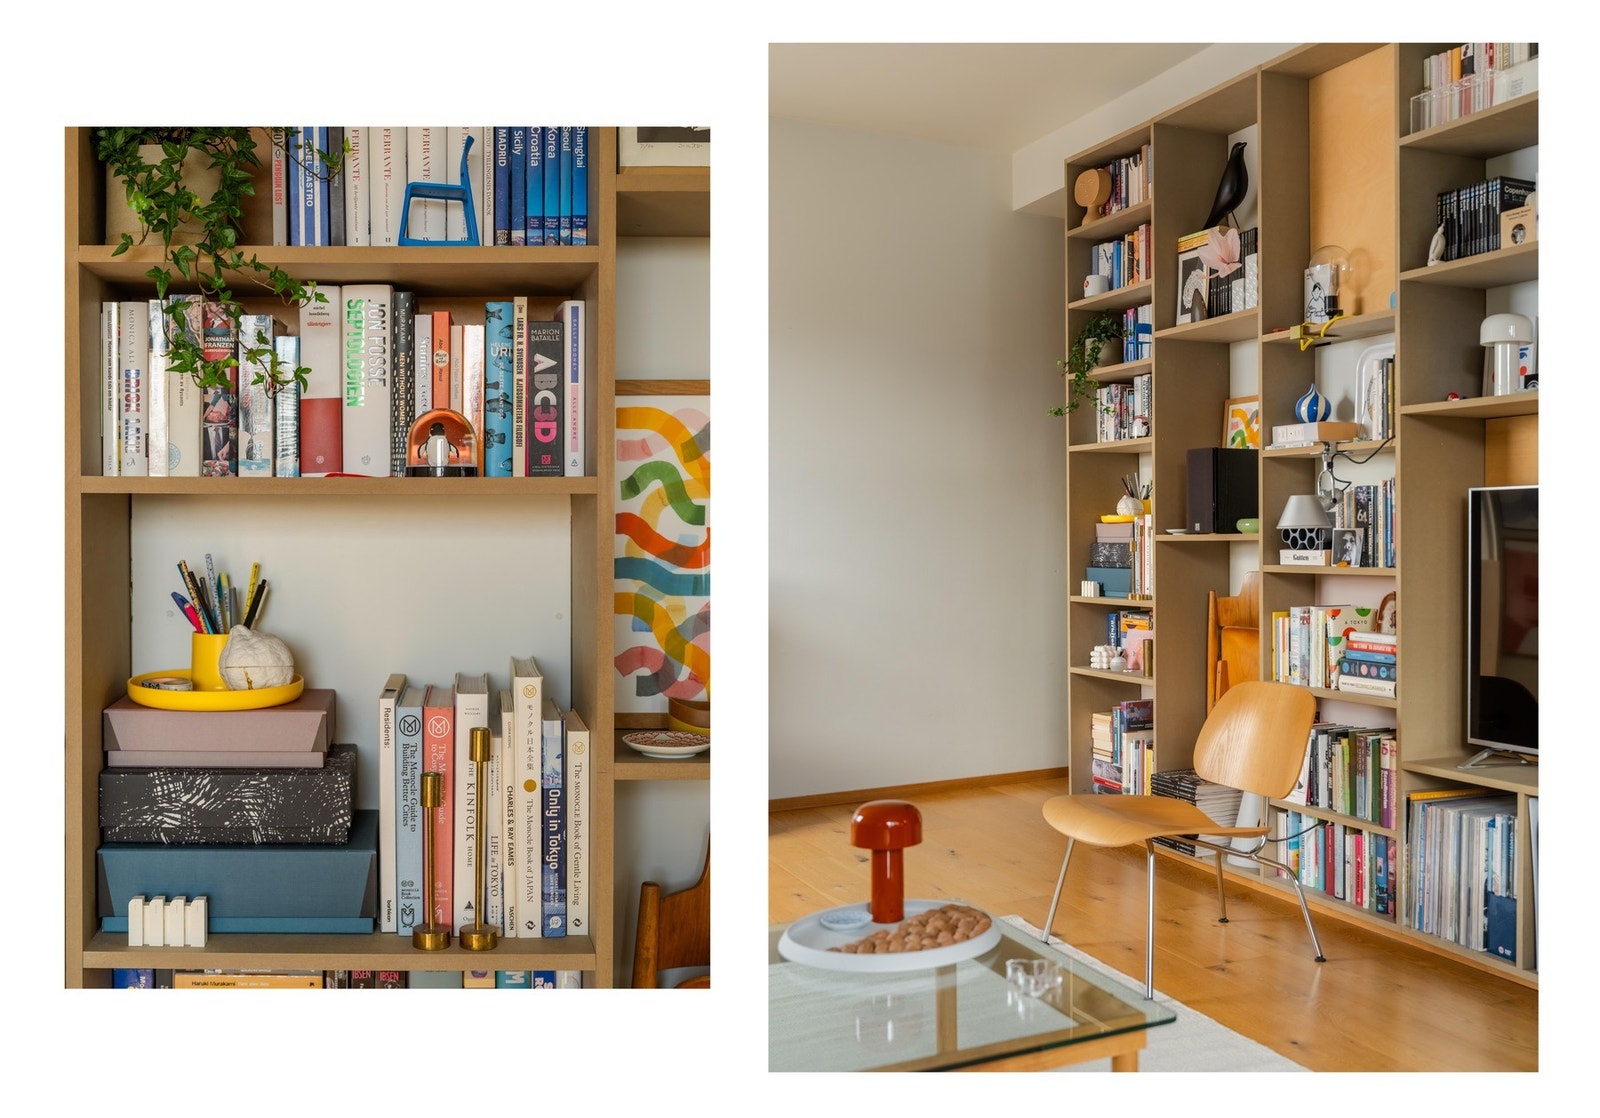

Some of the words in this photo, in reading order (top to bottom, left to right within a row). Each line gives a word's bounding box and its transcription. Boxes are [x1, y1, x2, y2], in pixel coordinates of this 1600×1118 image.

[498, 129, 507, 167] MADRID
[512, 130, 523, 155] Sicily
[530, 126, 541, 166] Croatia
[548, 126, 558, 158] Korea
[562, 126, 571, 151] Seoul
[574, 126, 585, 168] Shanghai
[351, 129, 361, 182] FERRANTE
[383, 128, 392, 181] FERRANTE
[422, 128, 431, 180] FERRANTE
[274, 160, 282, 188] PENGUIN
[305, 170, 313, 207] CASTRO
[368, 299, 386, 330] JON
[346, 298, 365, 407] SEPTOLOGIEN
[368, 336, 386, 388] FOSSE
[490, 347, 512, 357] URI
[125, 369, 140, 413] BRICK
[515, 378, 523, 424] KJEDSOMHETENS
[534, 353, 558, 443] ABC3D
[125, 418, 140, 453] LANE
[279, 420, 297, 459] FRANZEN
[515, 424, 523, 447] FILOSOFI
[1357, 509, 1367, 522] 64
[401, 743, 410, 776] Building
[432, 744, 438, 752] to
[438, 744, 446, 760] The
[574, 762, 582, 779] The
[402, 778, 410, 802] Better
[545, 789, 561, 817] Only
[402, 804, 410, 827] Cities
[466, 782, 475, 841] KINFOLK
[526, 799, 534, 813] The
[410, 823, 417, 832] to
[526, 815, 534, 845] Monocle
[549, 819, 561, 831] in
[574, 820, 582, 840] Book
[490, 835, 498, 856] LIFE
[526, 847, 534, 864] Book
[545, 833, 561, 870] Tokyo
[574, 842, 582, 850] of
[527, 866, 534, 874] of
[574, 852, 582, 878] Gentle
[490, 863, 498, 896] TOKYO
[525, 875, 534, 903] JAPAN
[572, 880, 582, 906] Living
[352, 970, 371, 979] IBSEN
[379, 971, 399, 981] IBSEN
